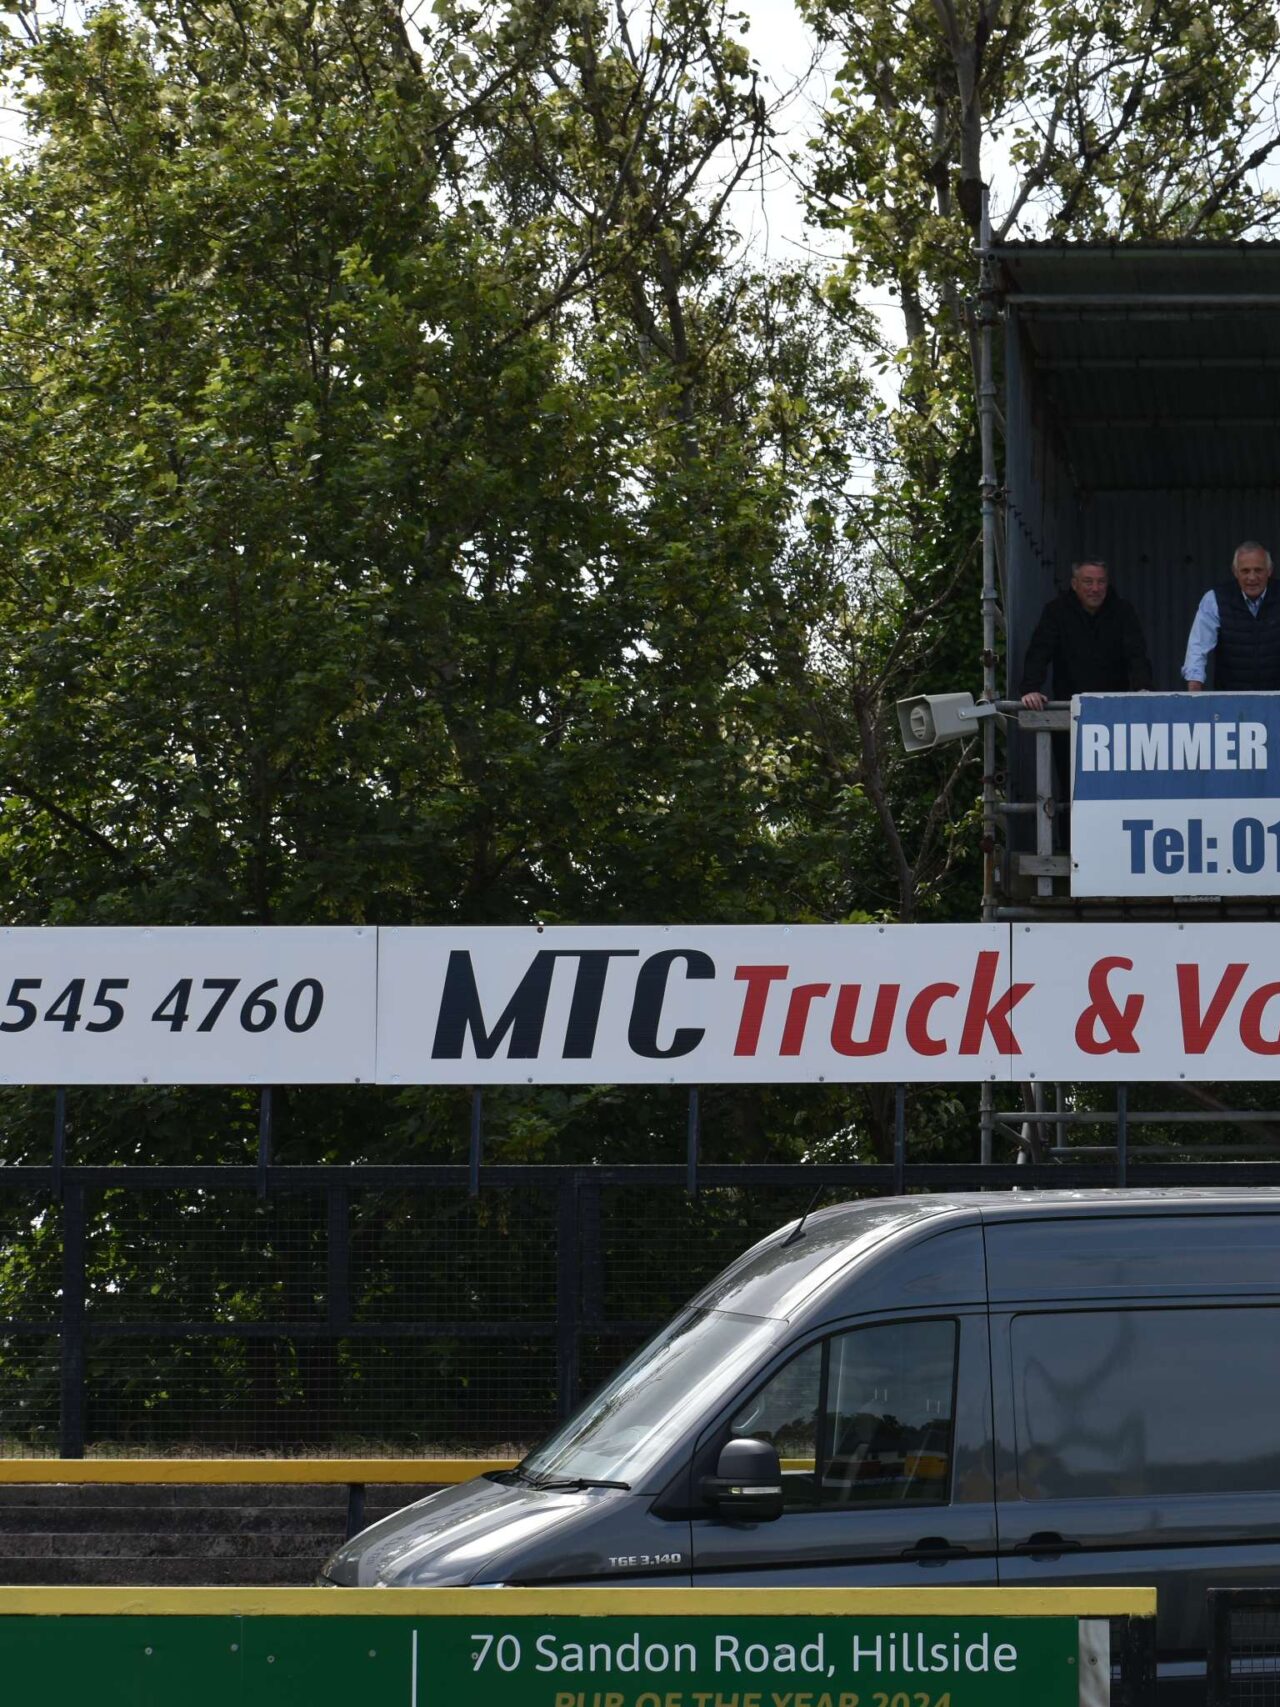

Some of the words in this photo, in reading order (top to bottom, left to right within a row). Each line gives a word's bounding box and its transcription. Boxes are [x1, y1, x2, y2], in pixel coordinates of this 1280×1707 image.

[1080, 722, 1269, 772] RIMMER
[1121, 818, 1218, 875] Tel:
[0, 977, 130, 1033] 545
[151, 977, 325, 1033] 4760
[430, 948, 717, 1060] MTC
[734, 951, 1033, 1057] Truck
[1076, 955, 1144, 1055] &
[608, 1555, 638, 1567] TGE
[640, 1552, 682, 1566] 3.140
[470, 1634, 522, 1673] 70
[535, 1632, 697, 1673] Sandon
[714, 1632, 836, 1679] Road,
[852, 1632, 1018, 1673] Hillside
